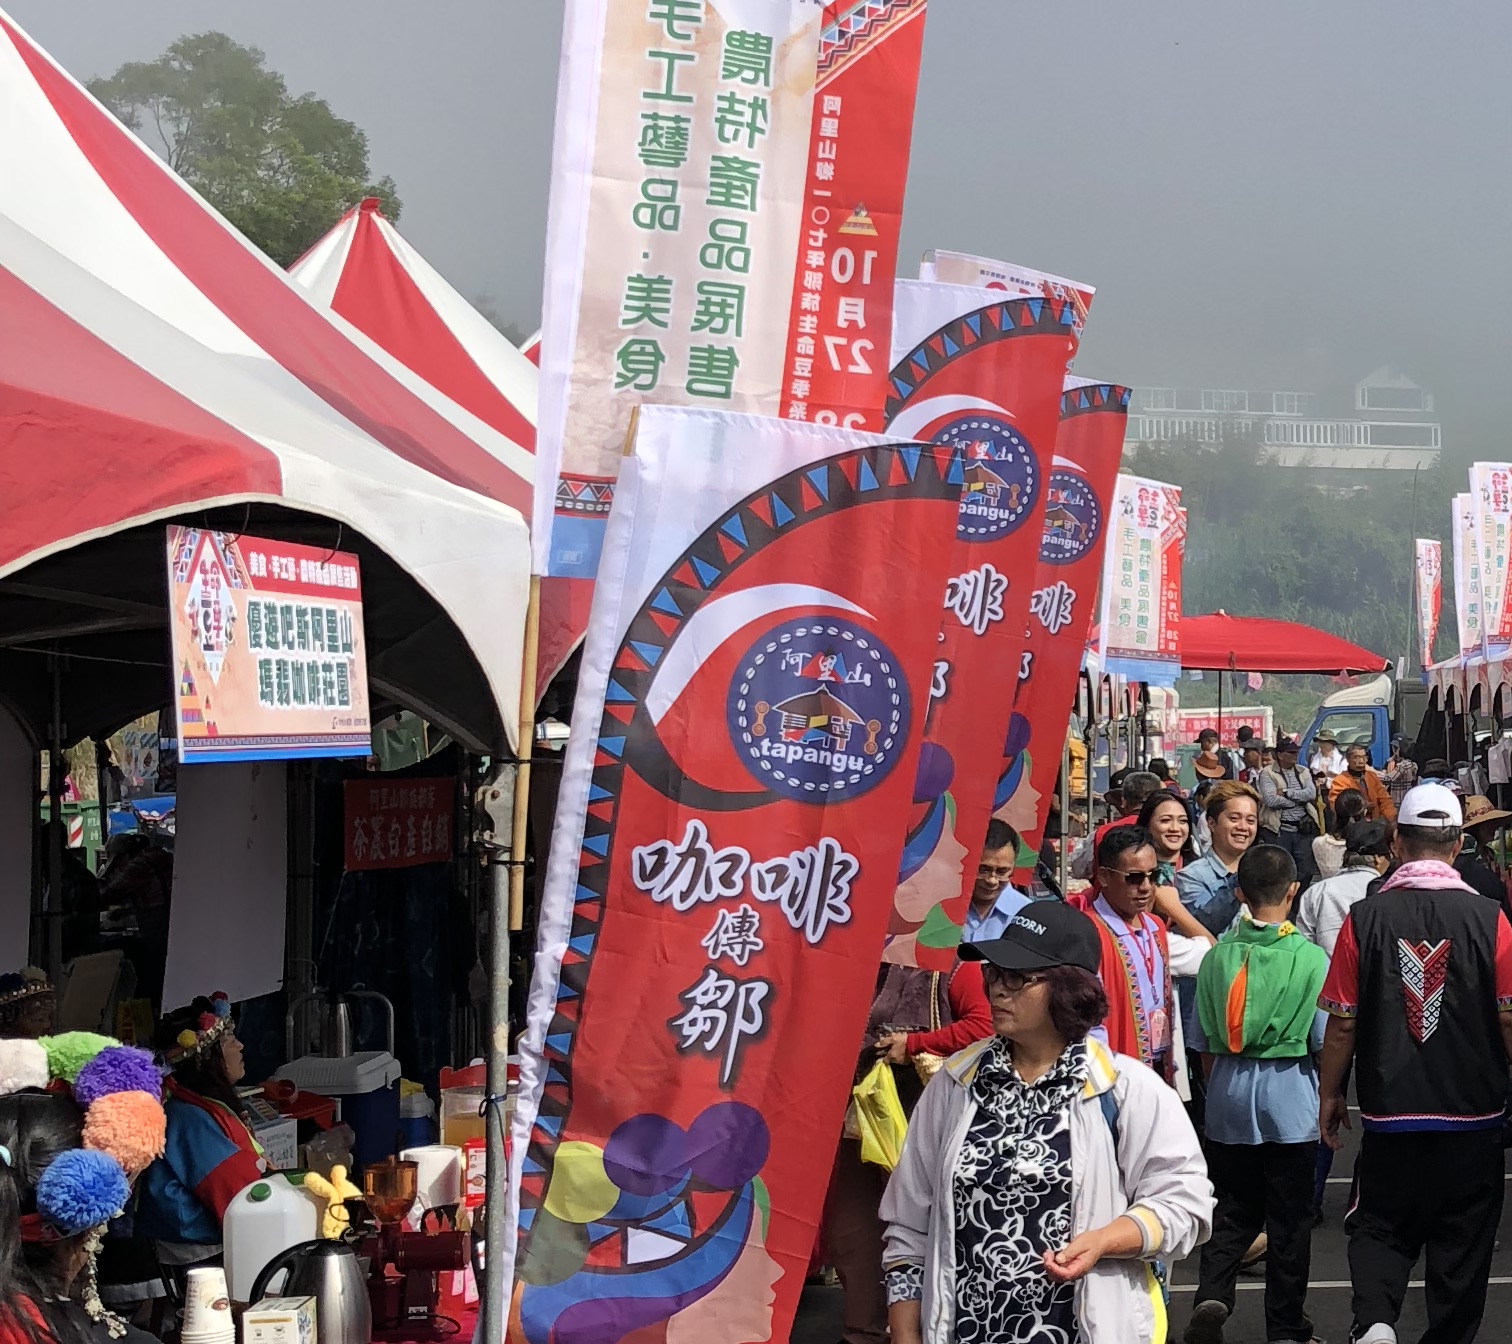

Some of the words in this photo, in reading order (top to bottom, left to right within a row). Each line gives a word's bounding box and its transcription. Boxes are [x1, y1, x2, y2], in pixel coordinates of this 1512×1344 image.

[958, 503, 1011, 522] pangu
[1042, 533, 1081, 551] pangu
[247, 600, 353, 655] 優遊吧斯阿里山
[780, 648, 874, 688] 阿里山
[760, 736, 866, 773] tapangu
[634, 820, 859, 942] 咖啡
[703, 906, 762, 965] 傳
